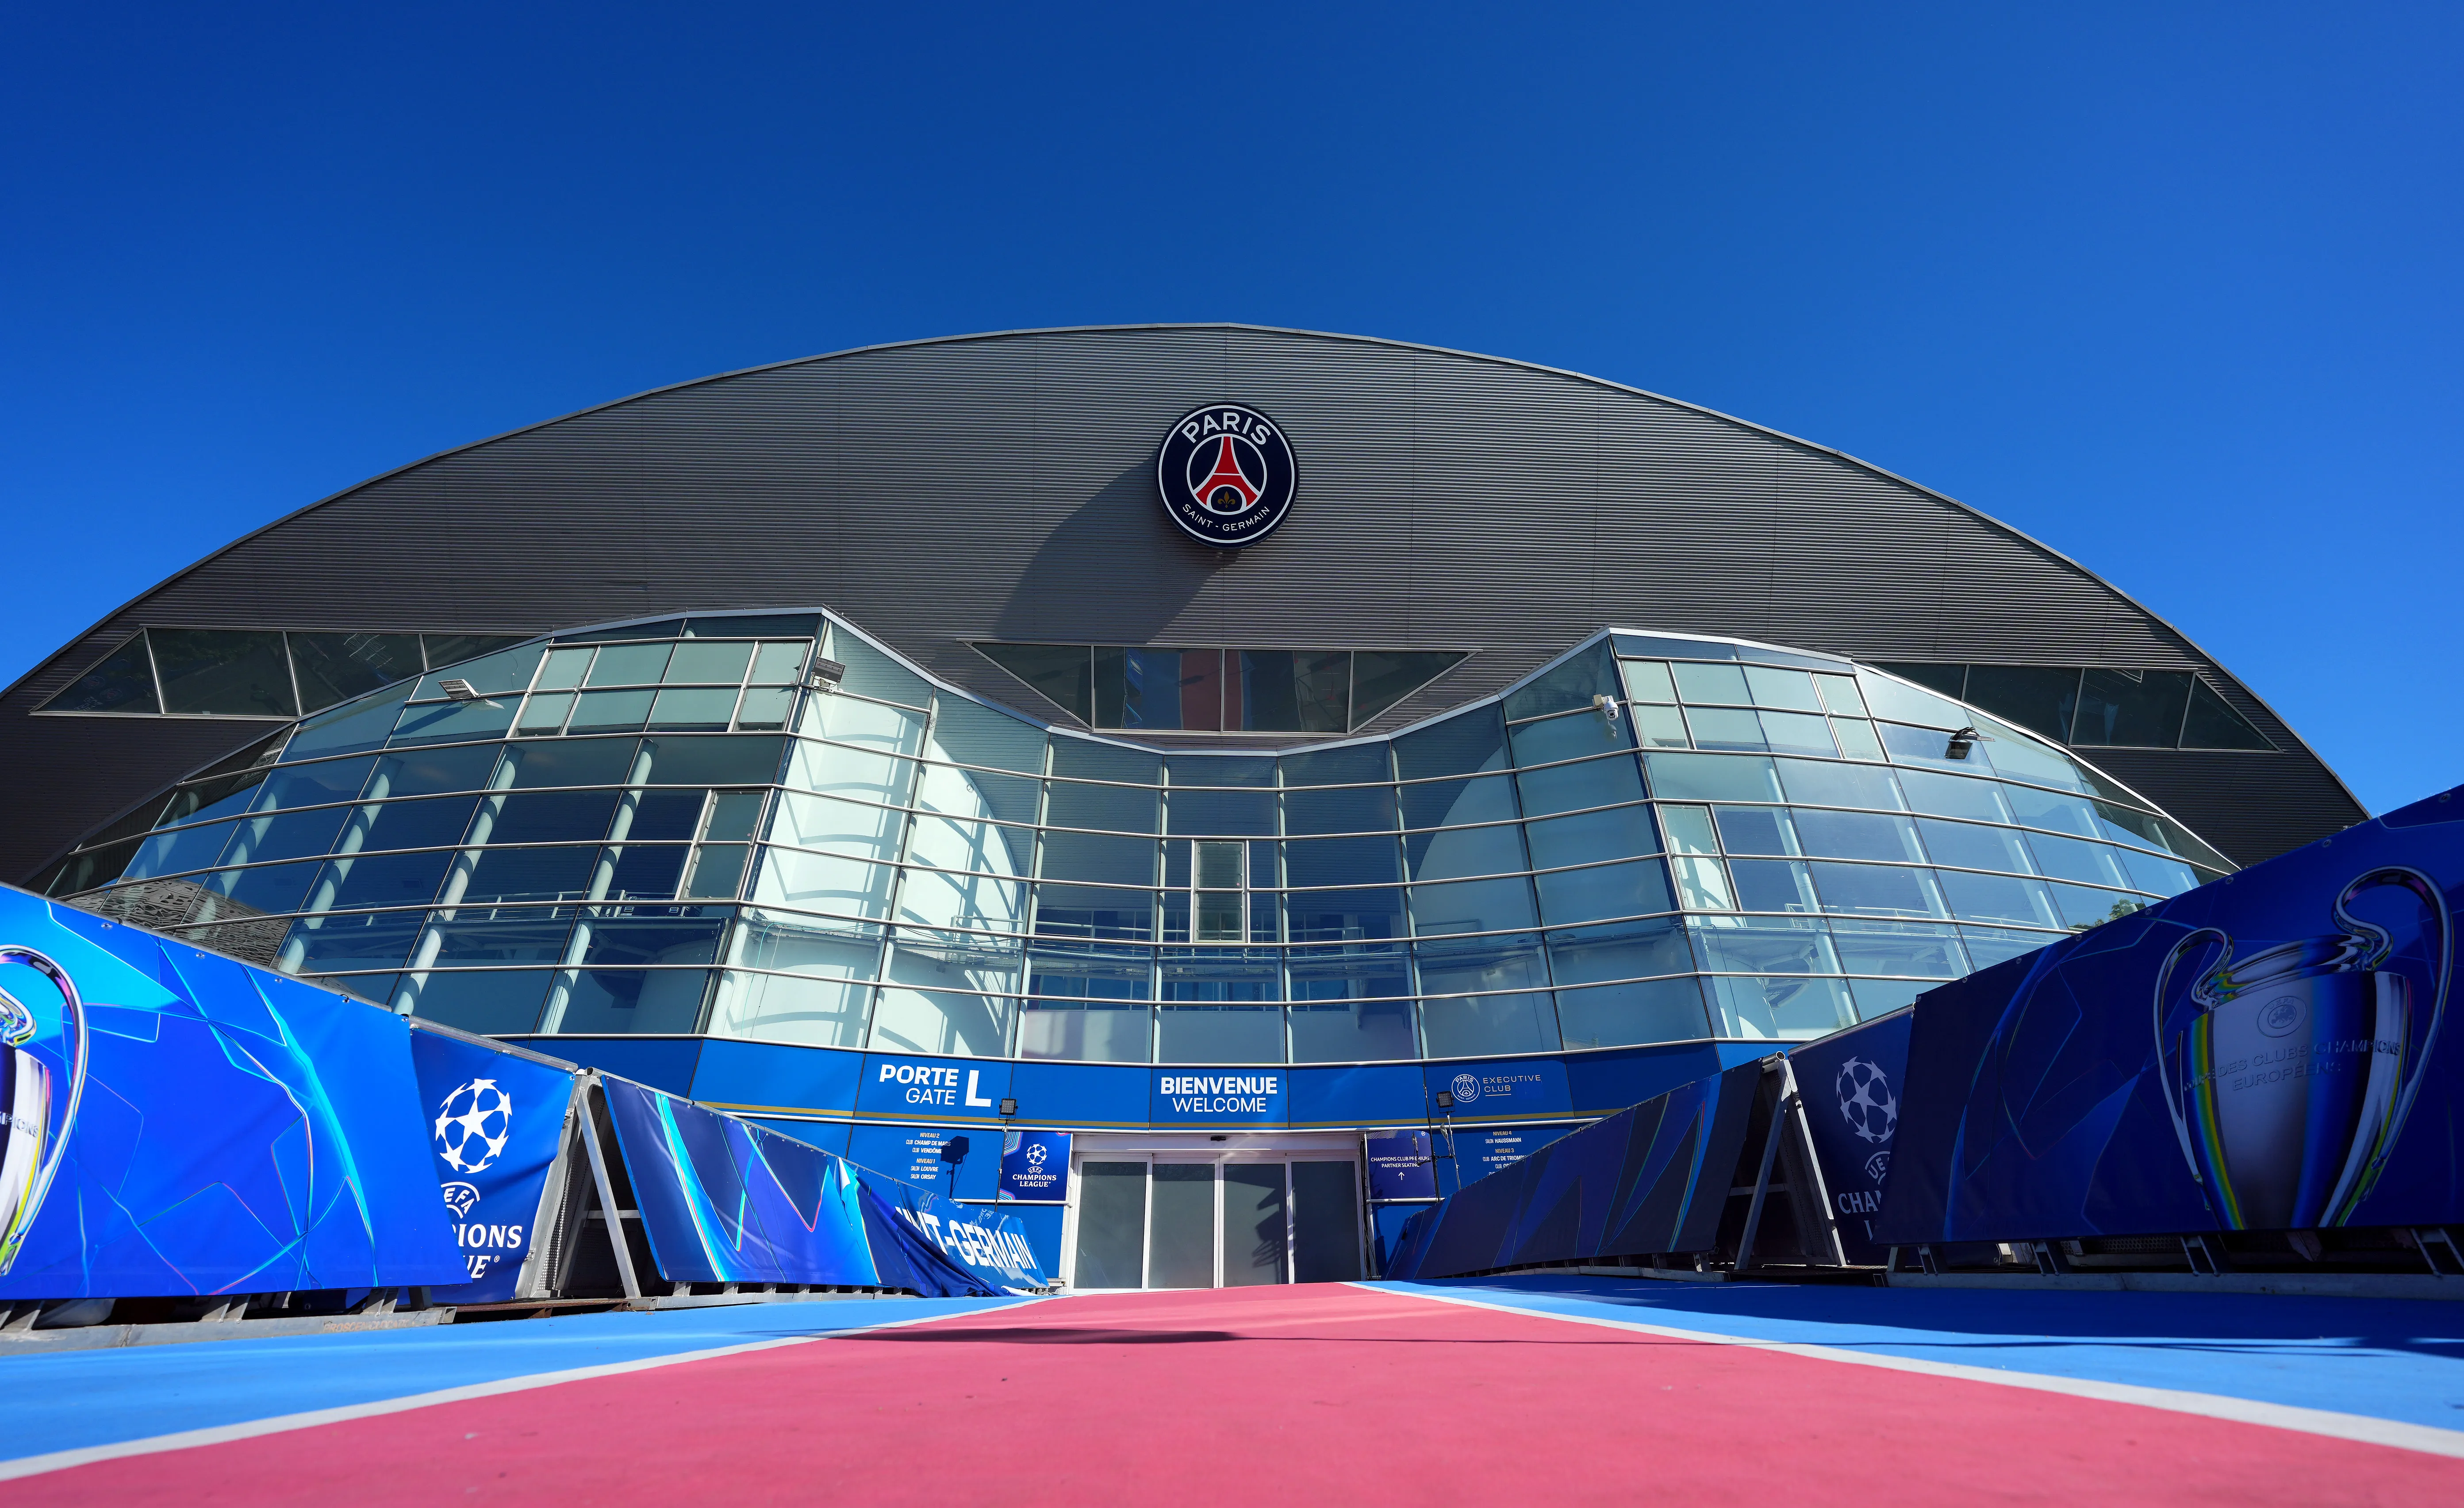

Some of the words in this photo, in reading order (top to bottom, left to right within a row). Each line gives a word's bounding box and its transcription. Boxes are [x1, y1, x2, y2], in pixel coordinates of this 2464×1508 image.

[1182, 412, 1270, 445] PARIS
[1182, 503, 1213, 528] SAINT
[1222, 506, 1270, 531] GERMAIN
[2218, 1059, 2248, 1078] DES
[2253, 1045, 2308, 1067] CLUBS
[879, 1064, 959, 1086] PORTE
[1160, 1077, 1278, 1094] BIENVENUE
[1483, 1074, 1541, 1084] EXECUTIVE
[906, 1087, 956, 1105] GATE
[965, 1070, 992, 1107] L
[1172, 1097, 1267, 1112] WELCOME
